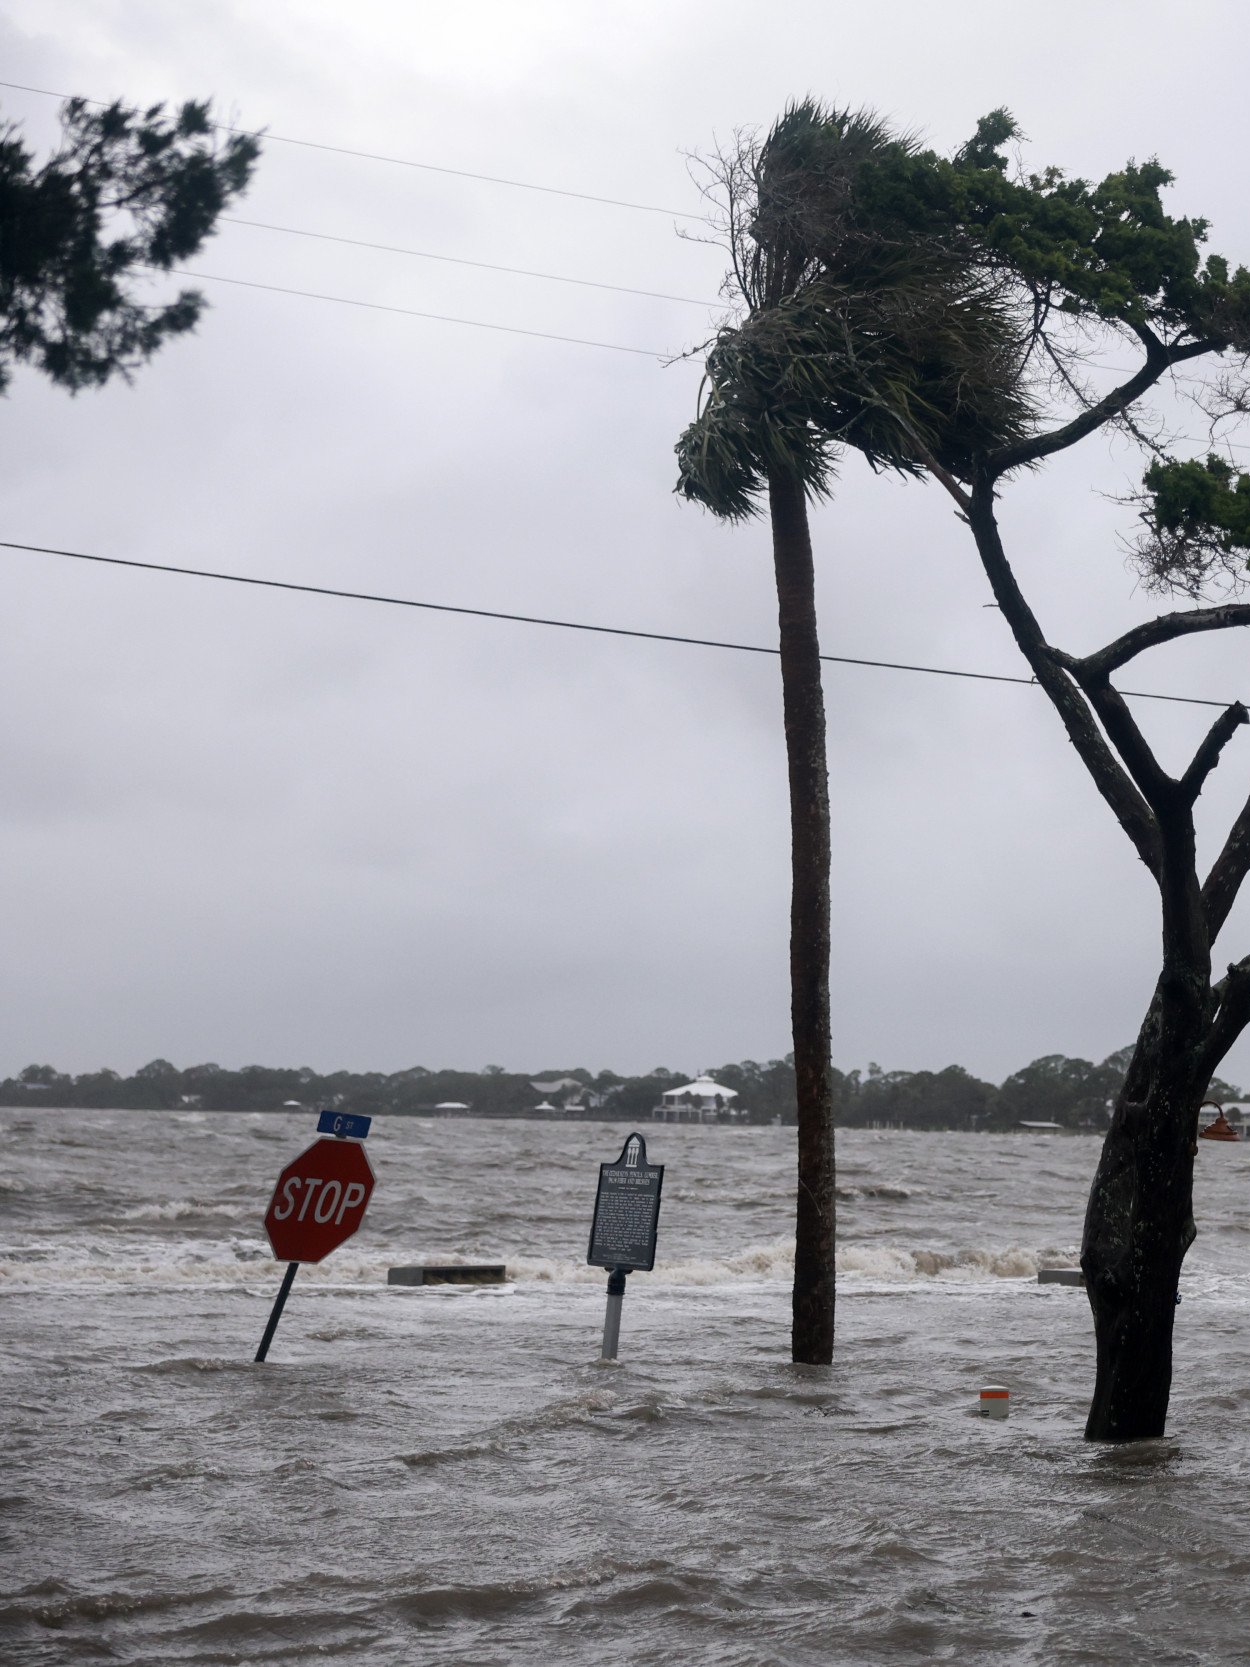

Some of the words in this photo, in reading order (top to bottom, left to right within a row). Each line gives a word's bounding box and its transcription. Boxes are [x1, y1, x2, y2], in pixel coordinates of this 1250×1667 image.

[333, 1116, 343, 1131] G
[346, 1121, 354, 1129] ST
[274, 1176, 366, 1225] STOP
